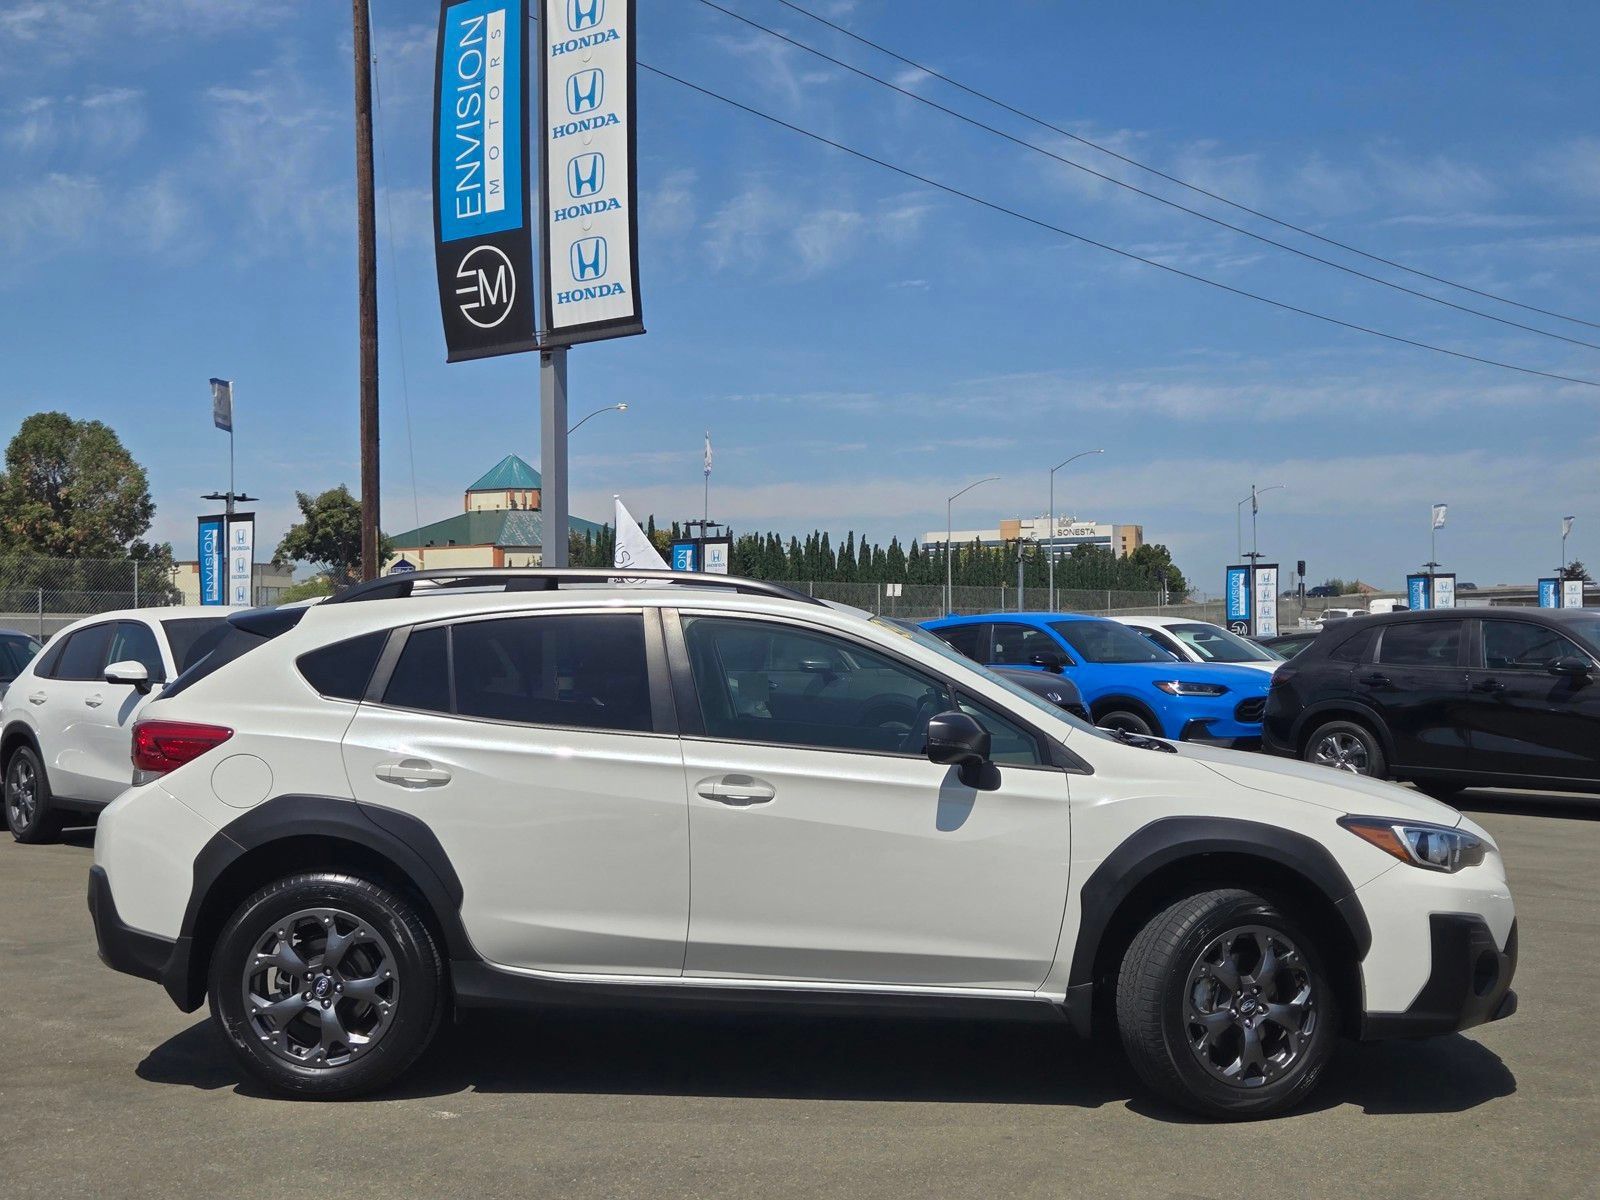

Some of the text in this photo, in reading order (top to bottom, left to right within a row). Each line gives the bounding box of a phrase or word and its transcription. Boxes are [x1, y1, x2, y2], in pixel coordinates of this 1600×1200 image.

[551, 28, 621, 57] HONDA
[456, 15, 485, 219] ENVISION
[489, 28, 502, 195] MOTORS
[552, 112, 621, 140] HONDA
[554, 197, 622, 223] HONDA
[557, 282, 626, 305] HONDA
[1057, 528, 1096, 537] SONESTA
[204, 529, 214, 602] ENVISION
[1231, 573, 1240, 616] ENVISION
